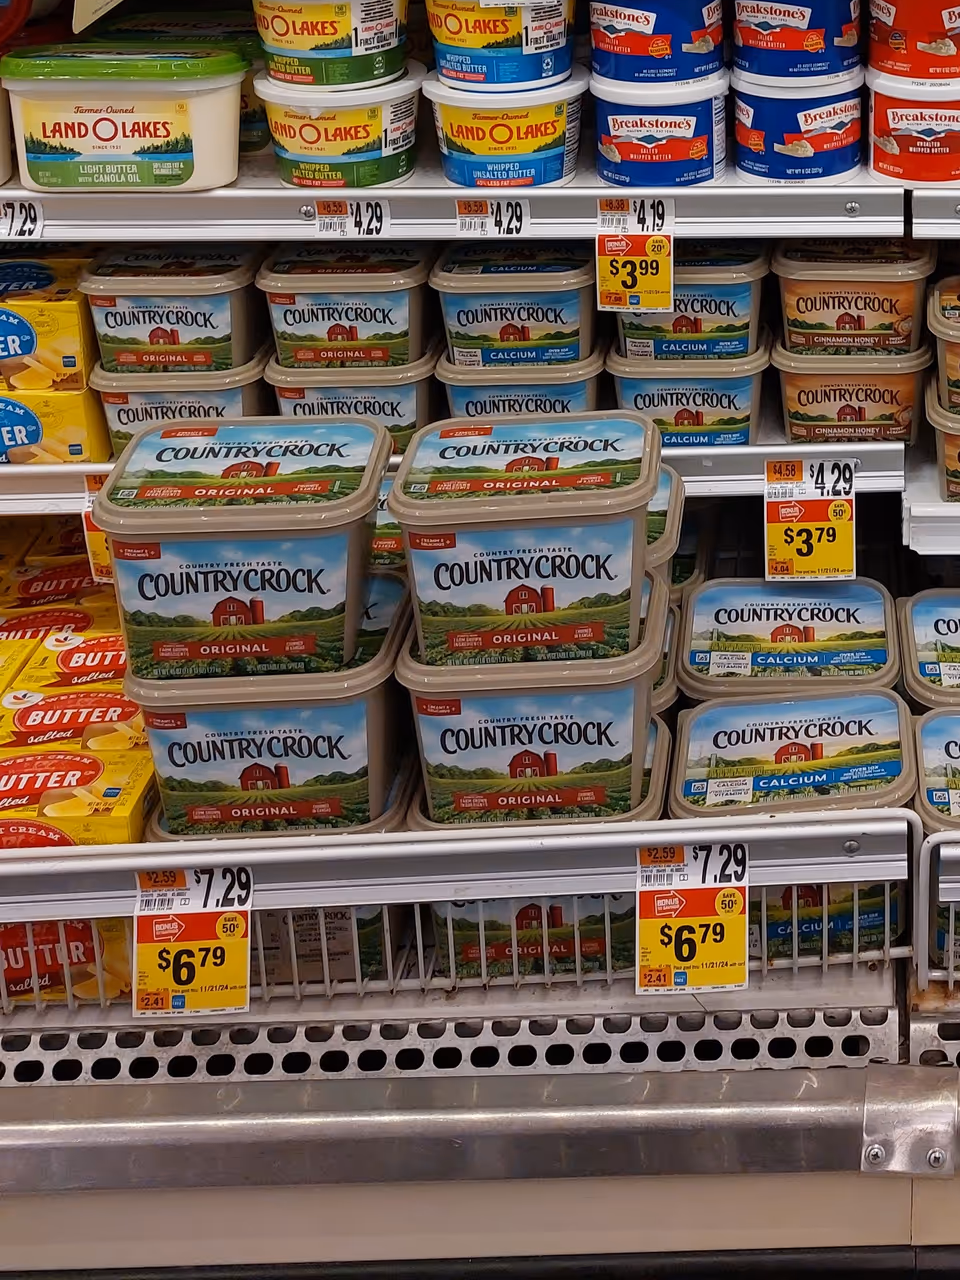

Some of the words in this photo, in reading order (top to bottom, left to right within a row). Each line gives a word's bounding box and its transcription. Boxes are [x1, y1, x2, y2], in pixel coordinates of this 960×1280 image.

[487, 163, 520, 172] WHIPPED
[473, 170, 507, 179] UNSALTED
[509, 169, 537, 179] BUTTER
[663, 343, 708, 352] CALCIUM
[810, 463, 853, 497] $4.29
[180, 561, 221, 571] COUNTRY
[224, 561, 253, 569] FRESH
[255, 561, 283, 569] TASTE
[27, 707, 123, 726] BUTTER
[693, 843, 747, 885] $7.29
[195, 867, 252, 909] $7.29
[701, 961, 729, 969] 11/21/24
[200, 985, 229, 994] 11/21/24
[141, 998, 165, 1007] $2.41
